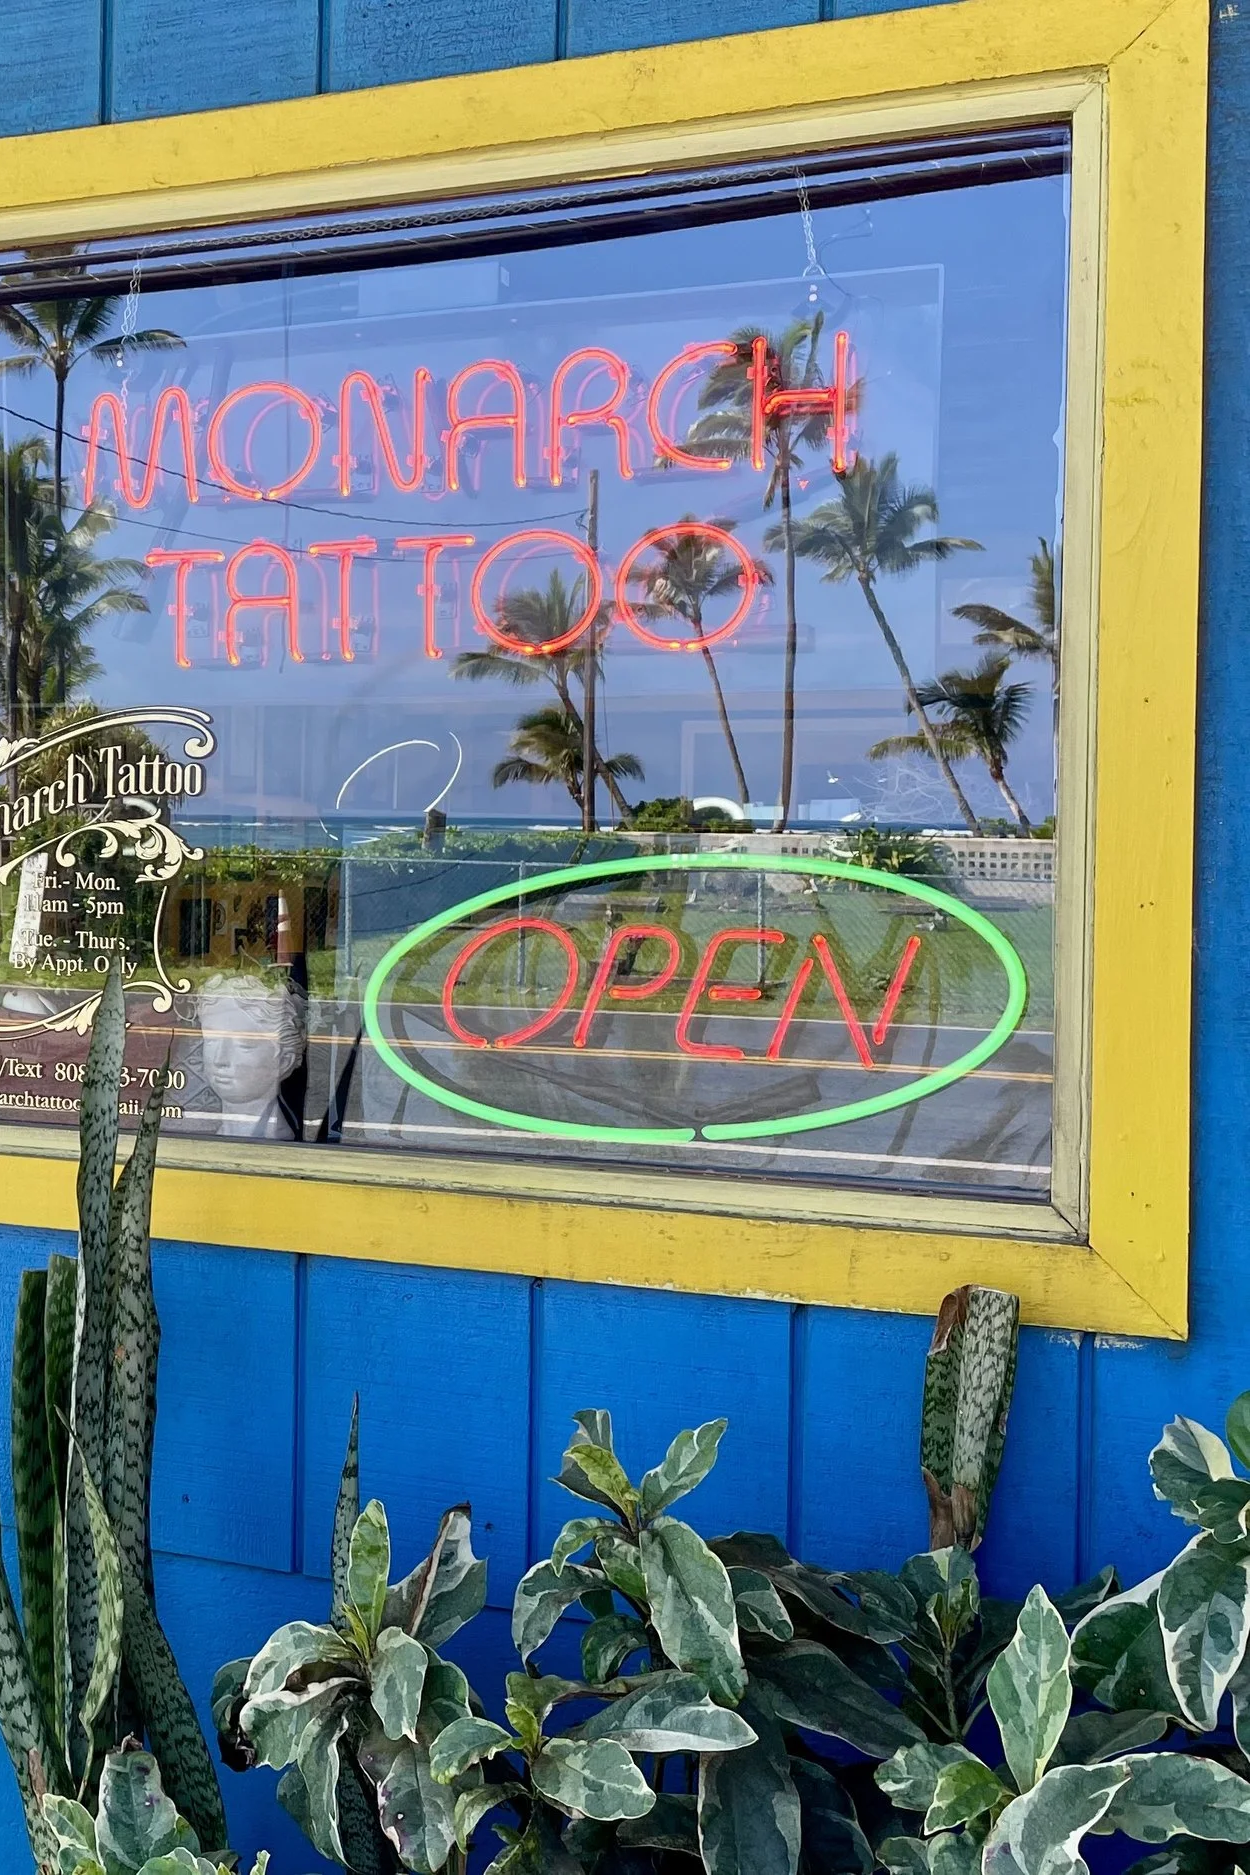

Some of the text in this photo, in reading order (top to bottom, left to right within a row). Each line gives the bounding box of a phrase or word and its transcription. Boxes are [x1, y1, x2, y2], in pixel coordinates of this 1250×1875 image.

[82, 330, 848, 508] MONARCH
[144, 521, 754, 667] TATTOO
[99, 745, 203, 800] Tattoo
[75, 871, 121, 891] Mon.
[24, 894, 68, 913] 11am
[86, 896, 124, 919] 5pm
[22, 928, 58, 948] Tue.
[75, 930, 130, 951] Thurs.
[13, 953, 138, 979] By Appt. Oly
[442, 916, 922, 1070] OPEN
